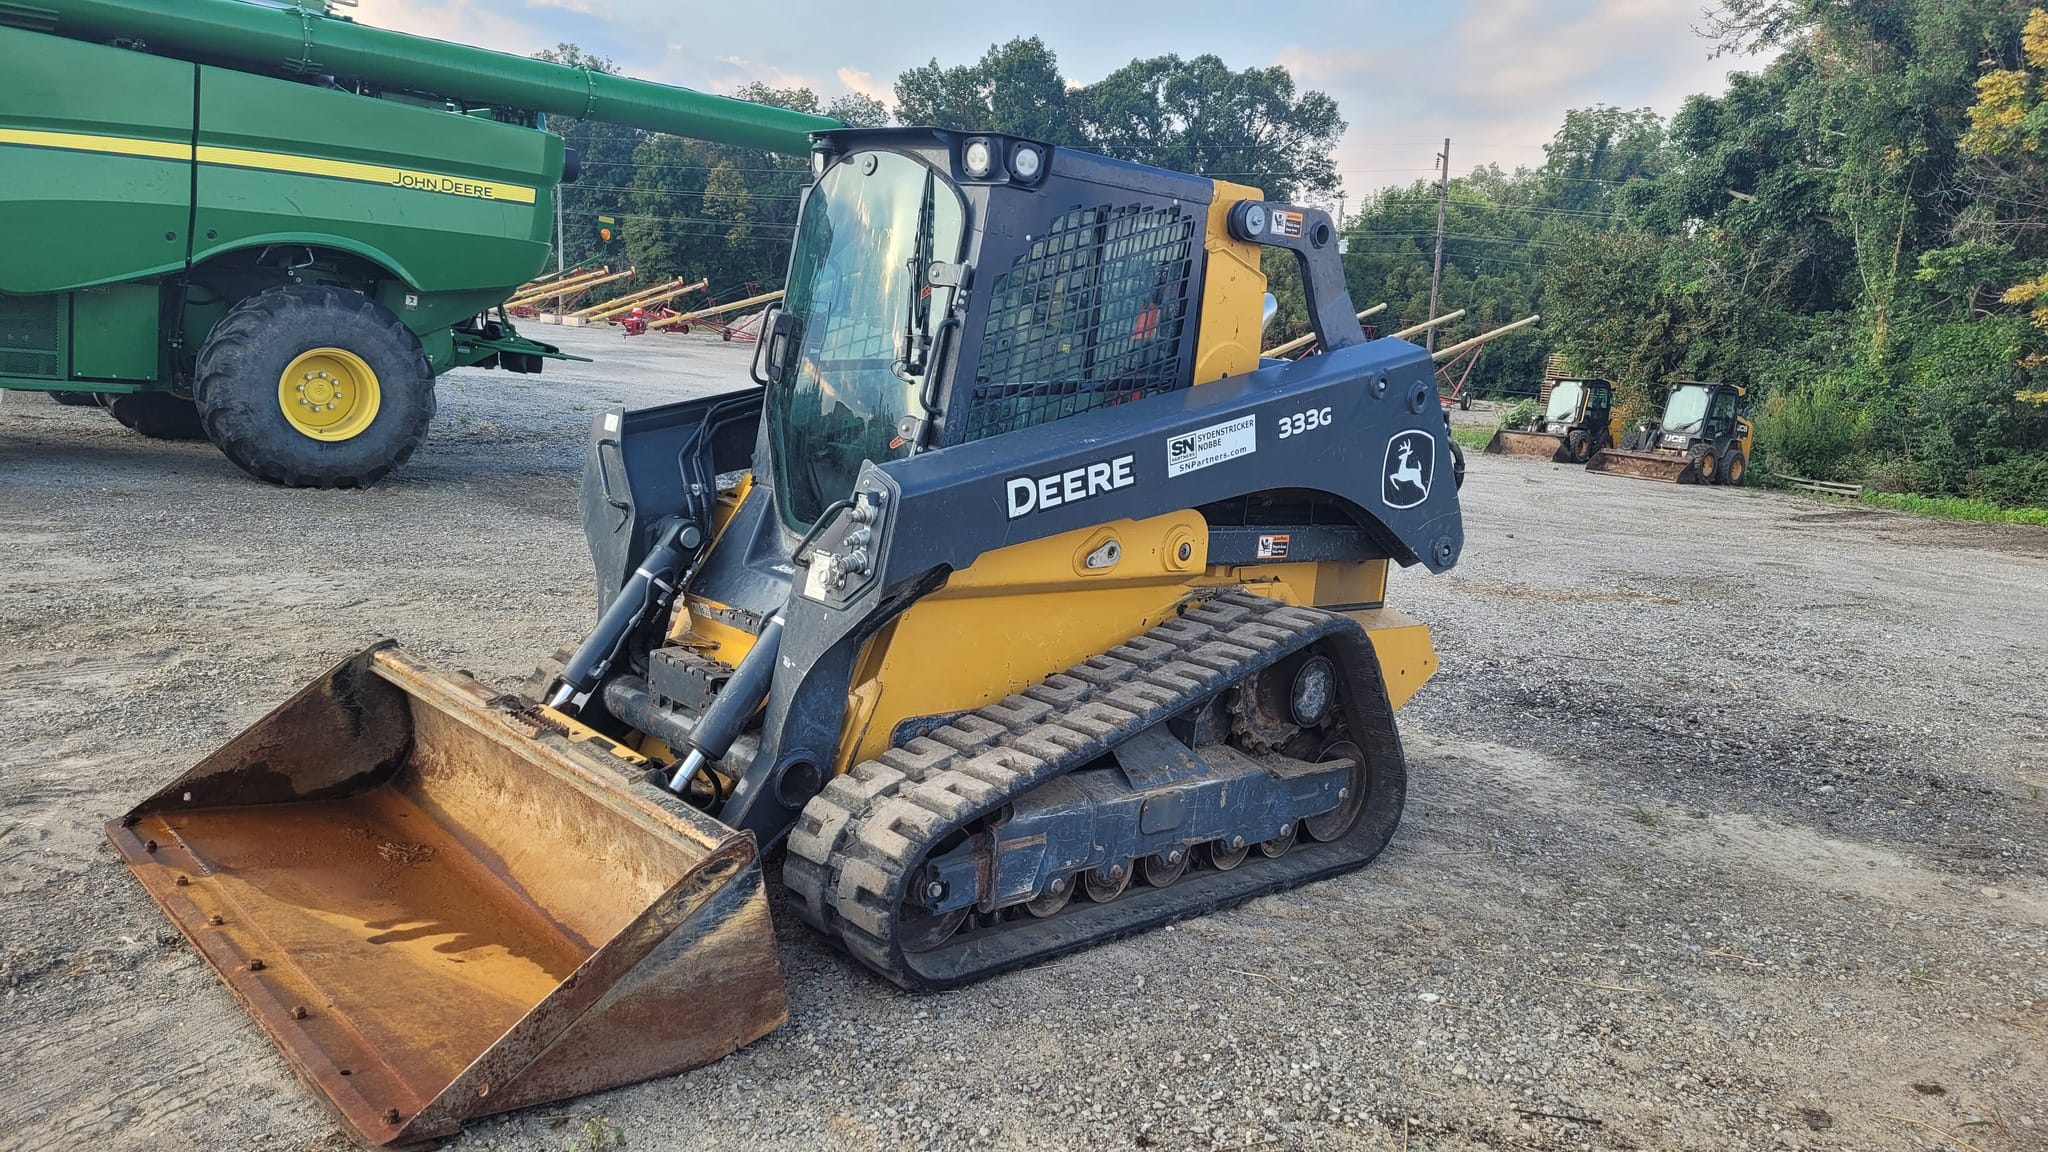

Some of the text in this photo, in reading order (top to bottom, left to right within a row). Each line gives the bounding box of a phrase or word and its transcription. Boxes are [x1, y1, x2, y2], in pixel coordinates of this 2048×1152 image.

[393, 172, 493, 197] JOHN DEERE
[1197, 419, 1254, 442] SYDENSTRICKER
[1279, 406, 1332, 439] 333G
[1171, 437, 1194, 456] SN
[1198, 439, 1222, 452] NOBBE
[1664, 434, 1686, 443] JCB
[1179, 446, 1247, 472] SNPartners.com
[1006, 454, 1135, 519] DEERE
